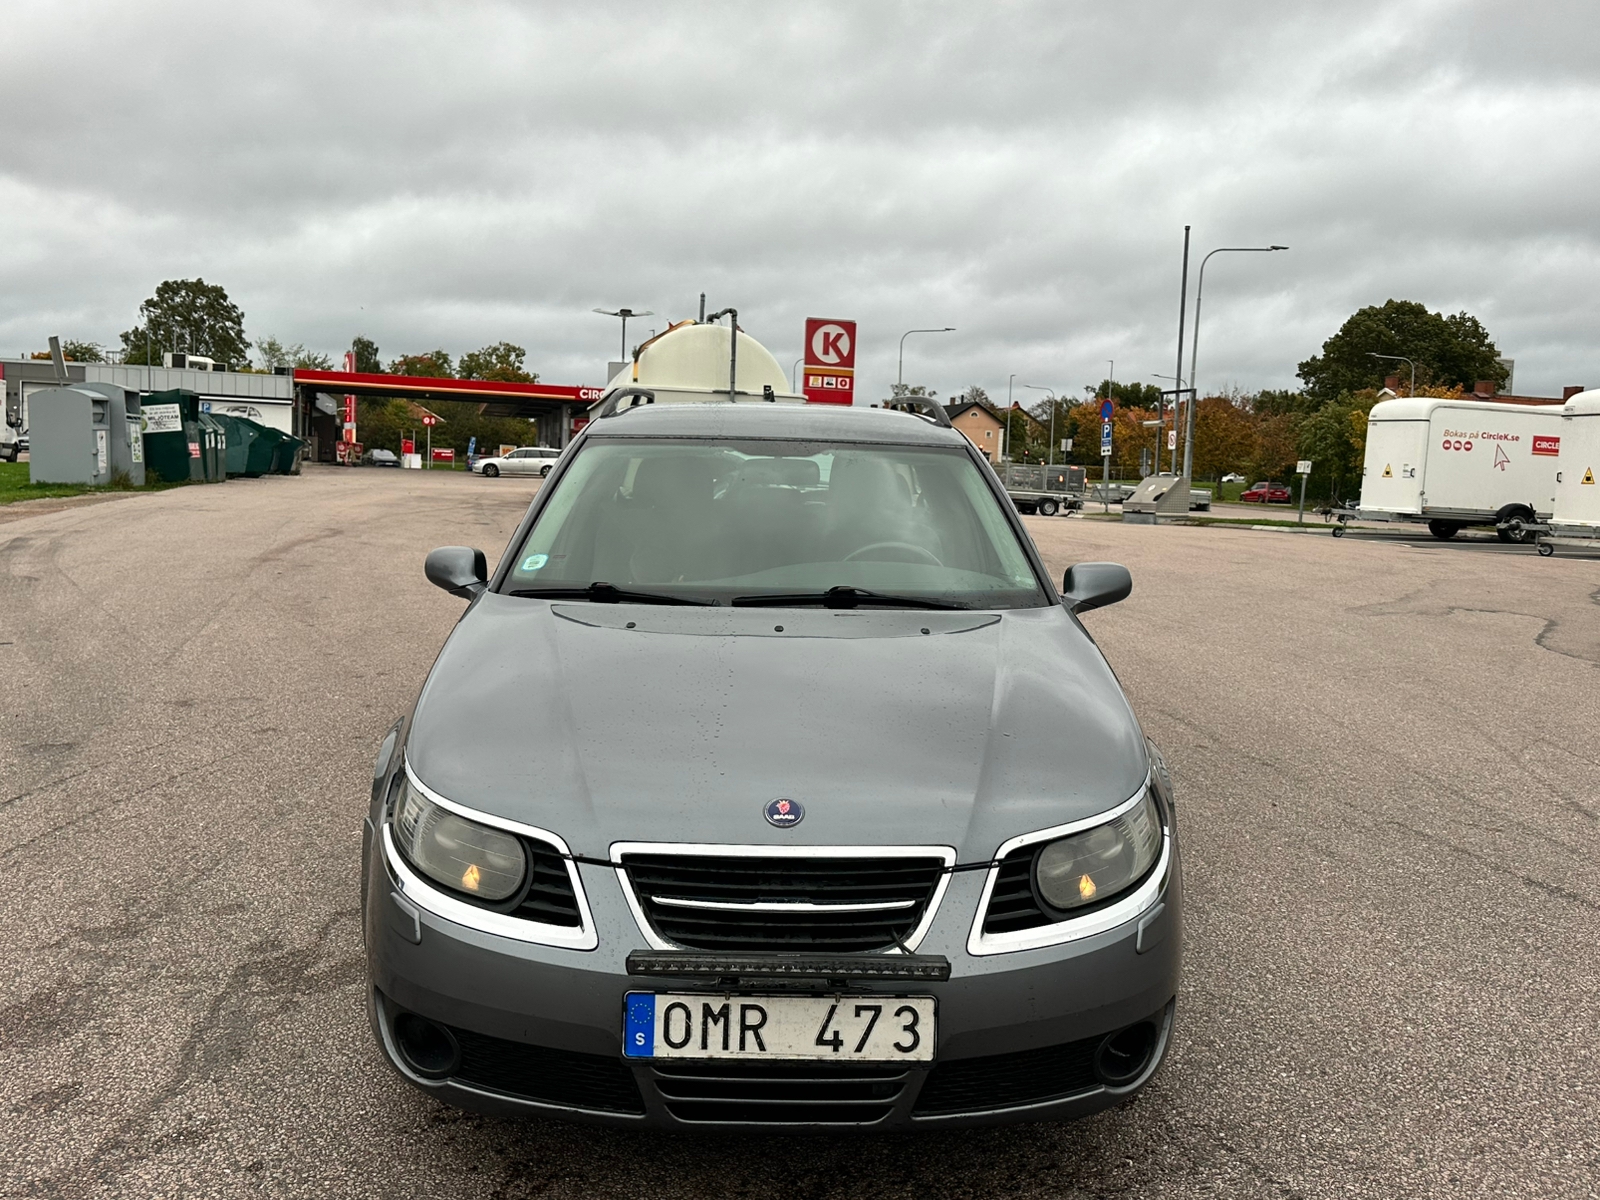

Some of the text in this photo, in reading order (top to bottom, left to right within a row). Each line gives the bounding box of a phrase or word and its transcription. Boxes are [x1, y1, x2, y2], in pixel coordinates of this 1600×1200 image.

[203, 403, 210, 413] P
[1103, 424, 1110, 438] P
[1443, 429, 1520, 442] Bokas på CircleK.se
[663, 1002, 921, 1053] OMR 473
[635, 1032, 645, 1046] S
